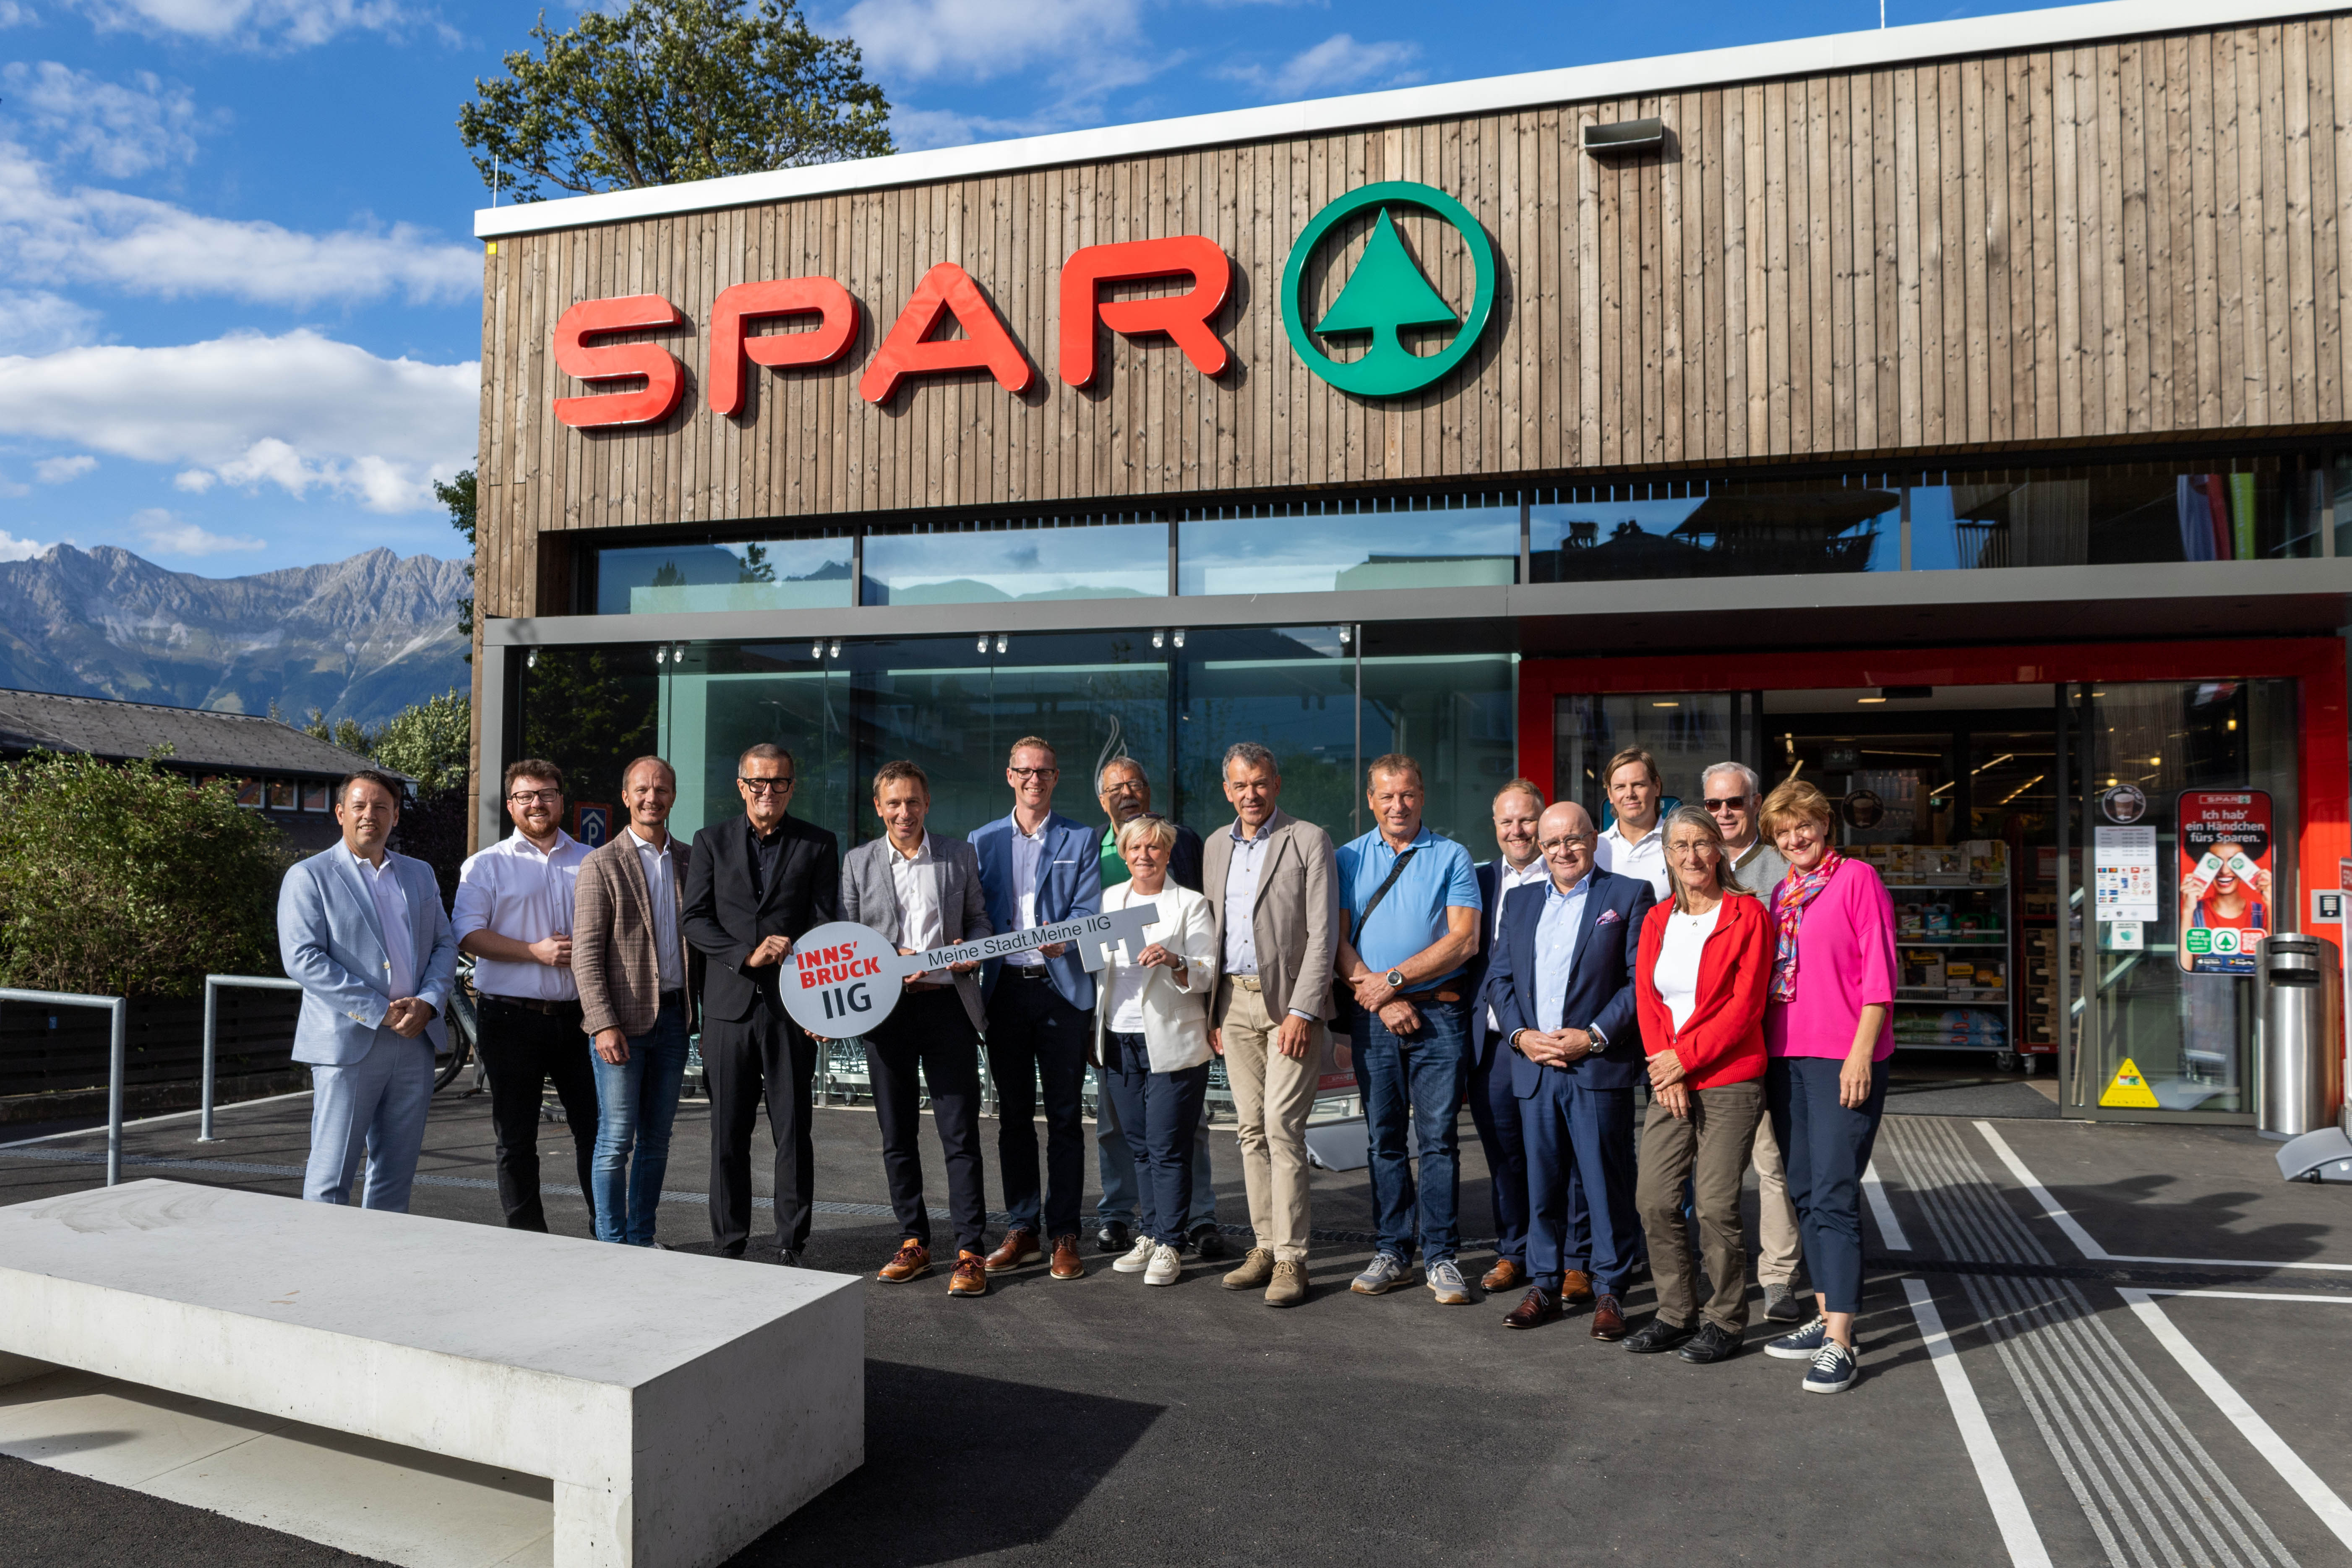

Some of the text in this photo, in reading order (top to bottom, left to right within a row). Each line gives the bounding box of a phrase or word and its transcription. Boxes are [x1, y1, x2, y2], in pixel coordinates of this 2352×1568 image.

[553, 235, 1233, 429] SPAR
[2185, 821, 2265, 831] ein Händchen
[2202, 810, 2248, 819] Ich hab'
[588, 822, 599, 846] P
[2190, 832, 2261, 844] fürs Sparen.
[797, 941, 858, 970] INNS'
[928, 946, 979, 967] Meine
[1086, 916, 1111, 933] IIG
[800, 956, 881, 989] BRUCK
[822, 982, 872, 1019] IIG
